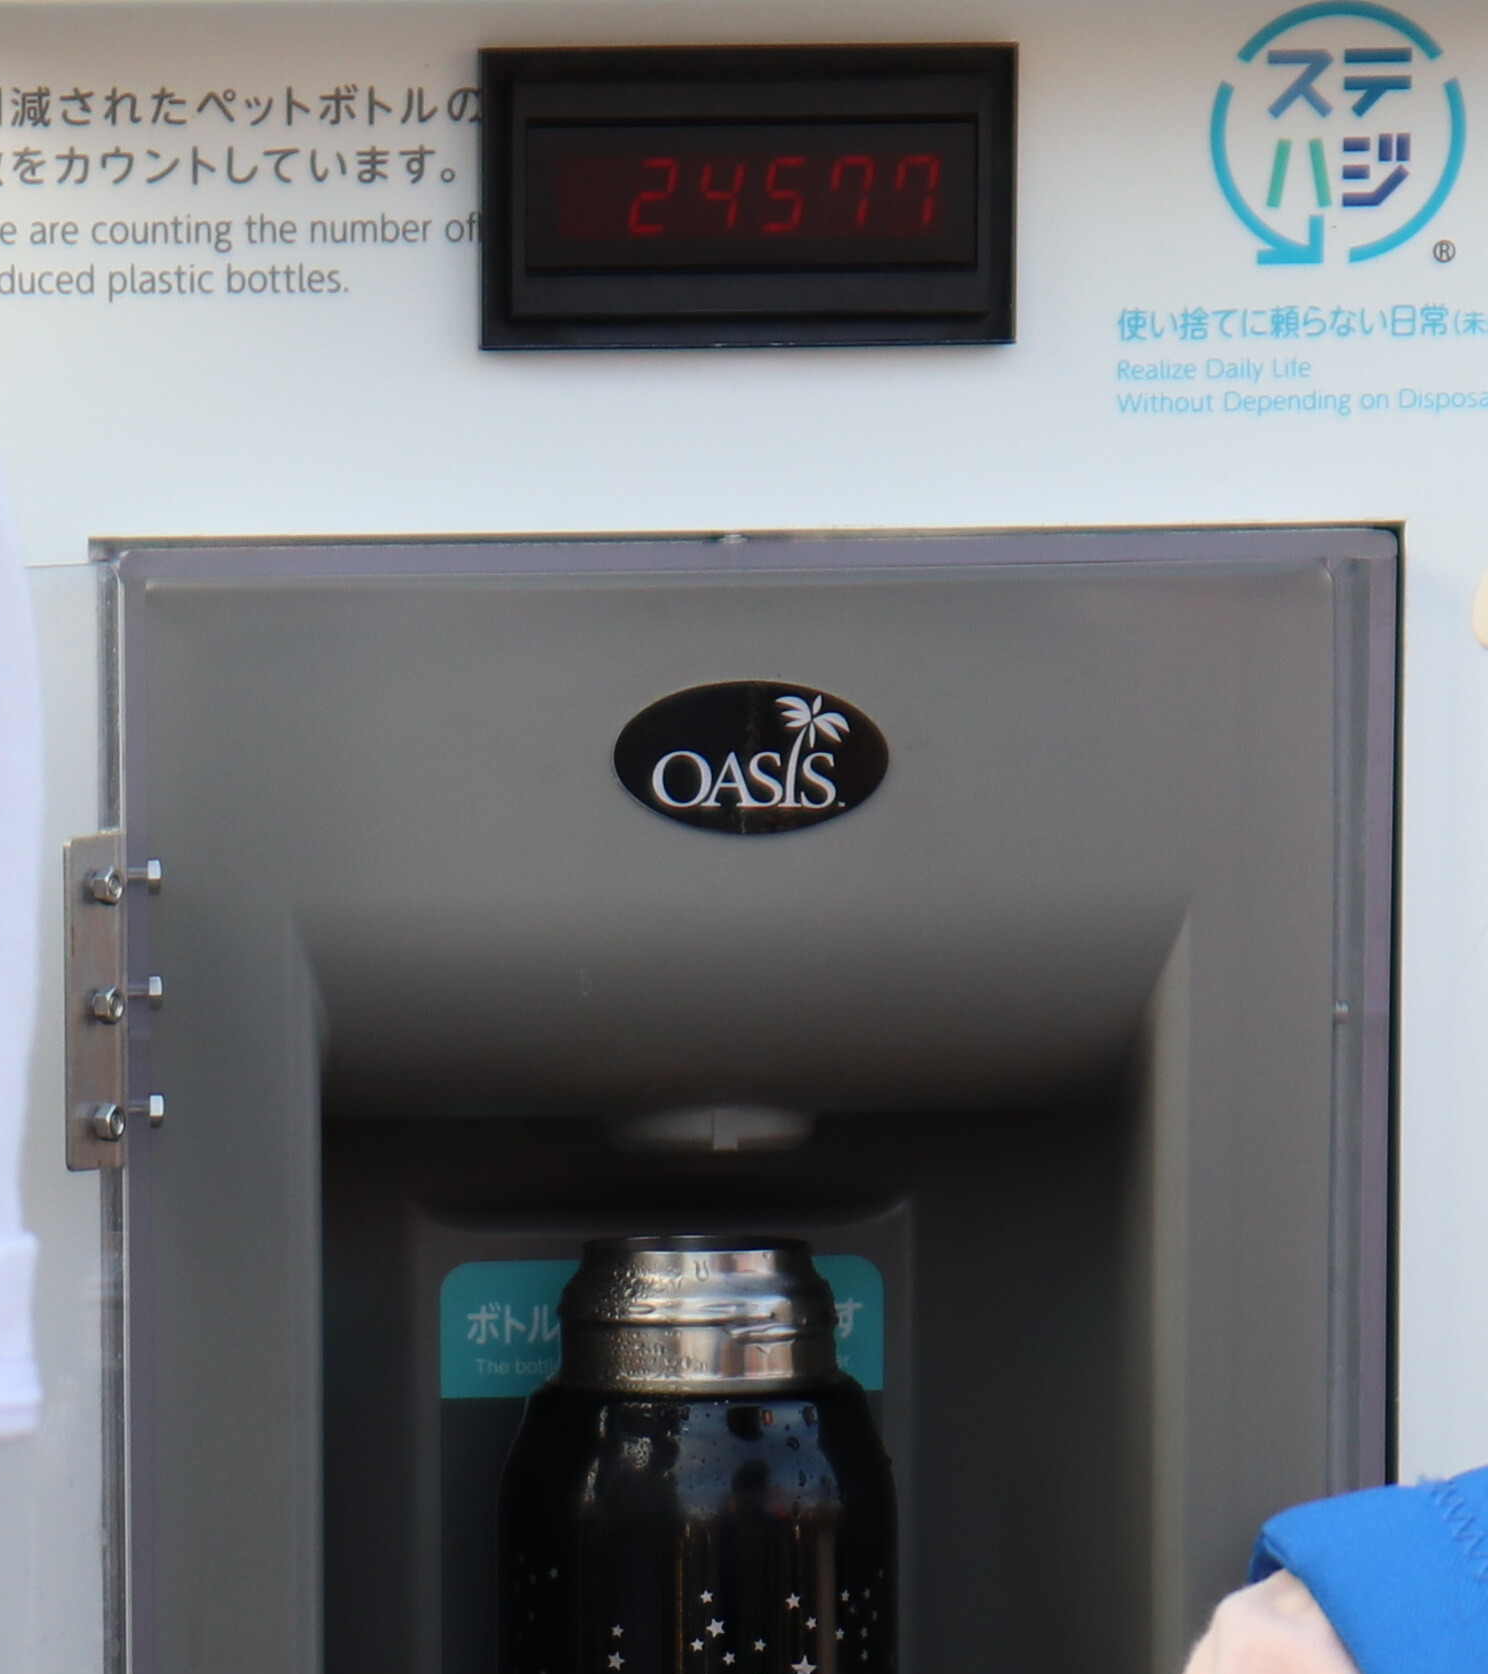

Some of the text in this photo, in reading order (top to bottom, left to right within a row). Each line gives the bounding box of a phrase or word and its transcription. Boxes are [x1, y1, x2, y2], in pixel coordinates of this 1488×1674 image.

[627, 157, 942, 235] 24577
[29, 220, 79, 245] are
[91, 214, 233, 253] counting
[245, 213, 298, 244] the
[310, 212, 432, 244] number
[445, 211, 476, 243] of
[108, 264, 215, 302] plastic
[227, 263, 349, 294] bottles.
[1117, 357, 1312, 383] Realize Daily Life
[1117, 392, 1214, 413] Without
[1224, 390, 1352, 416] Depending
[1360, 393, 1389, 410] on
[652, 726, 839, 809] OASIS
[467, 1302, 561, 1345] ボトル
[475, 1358, 510, 1375] The
